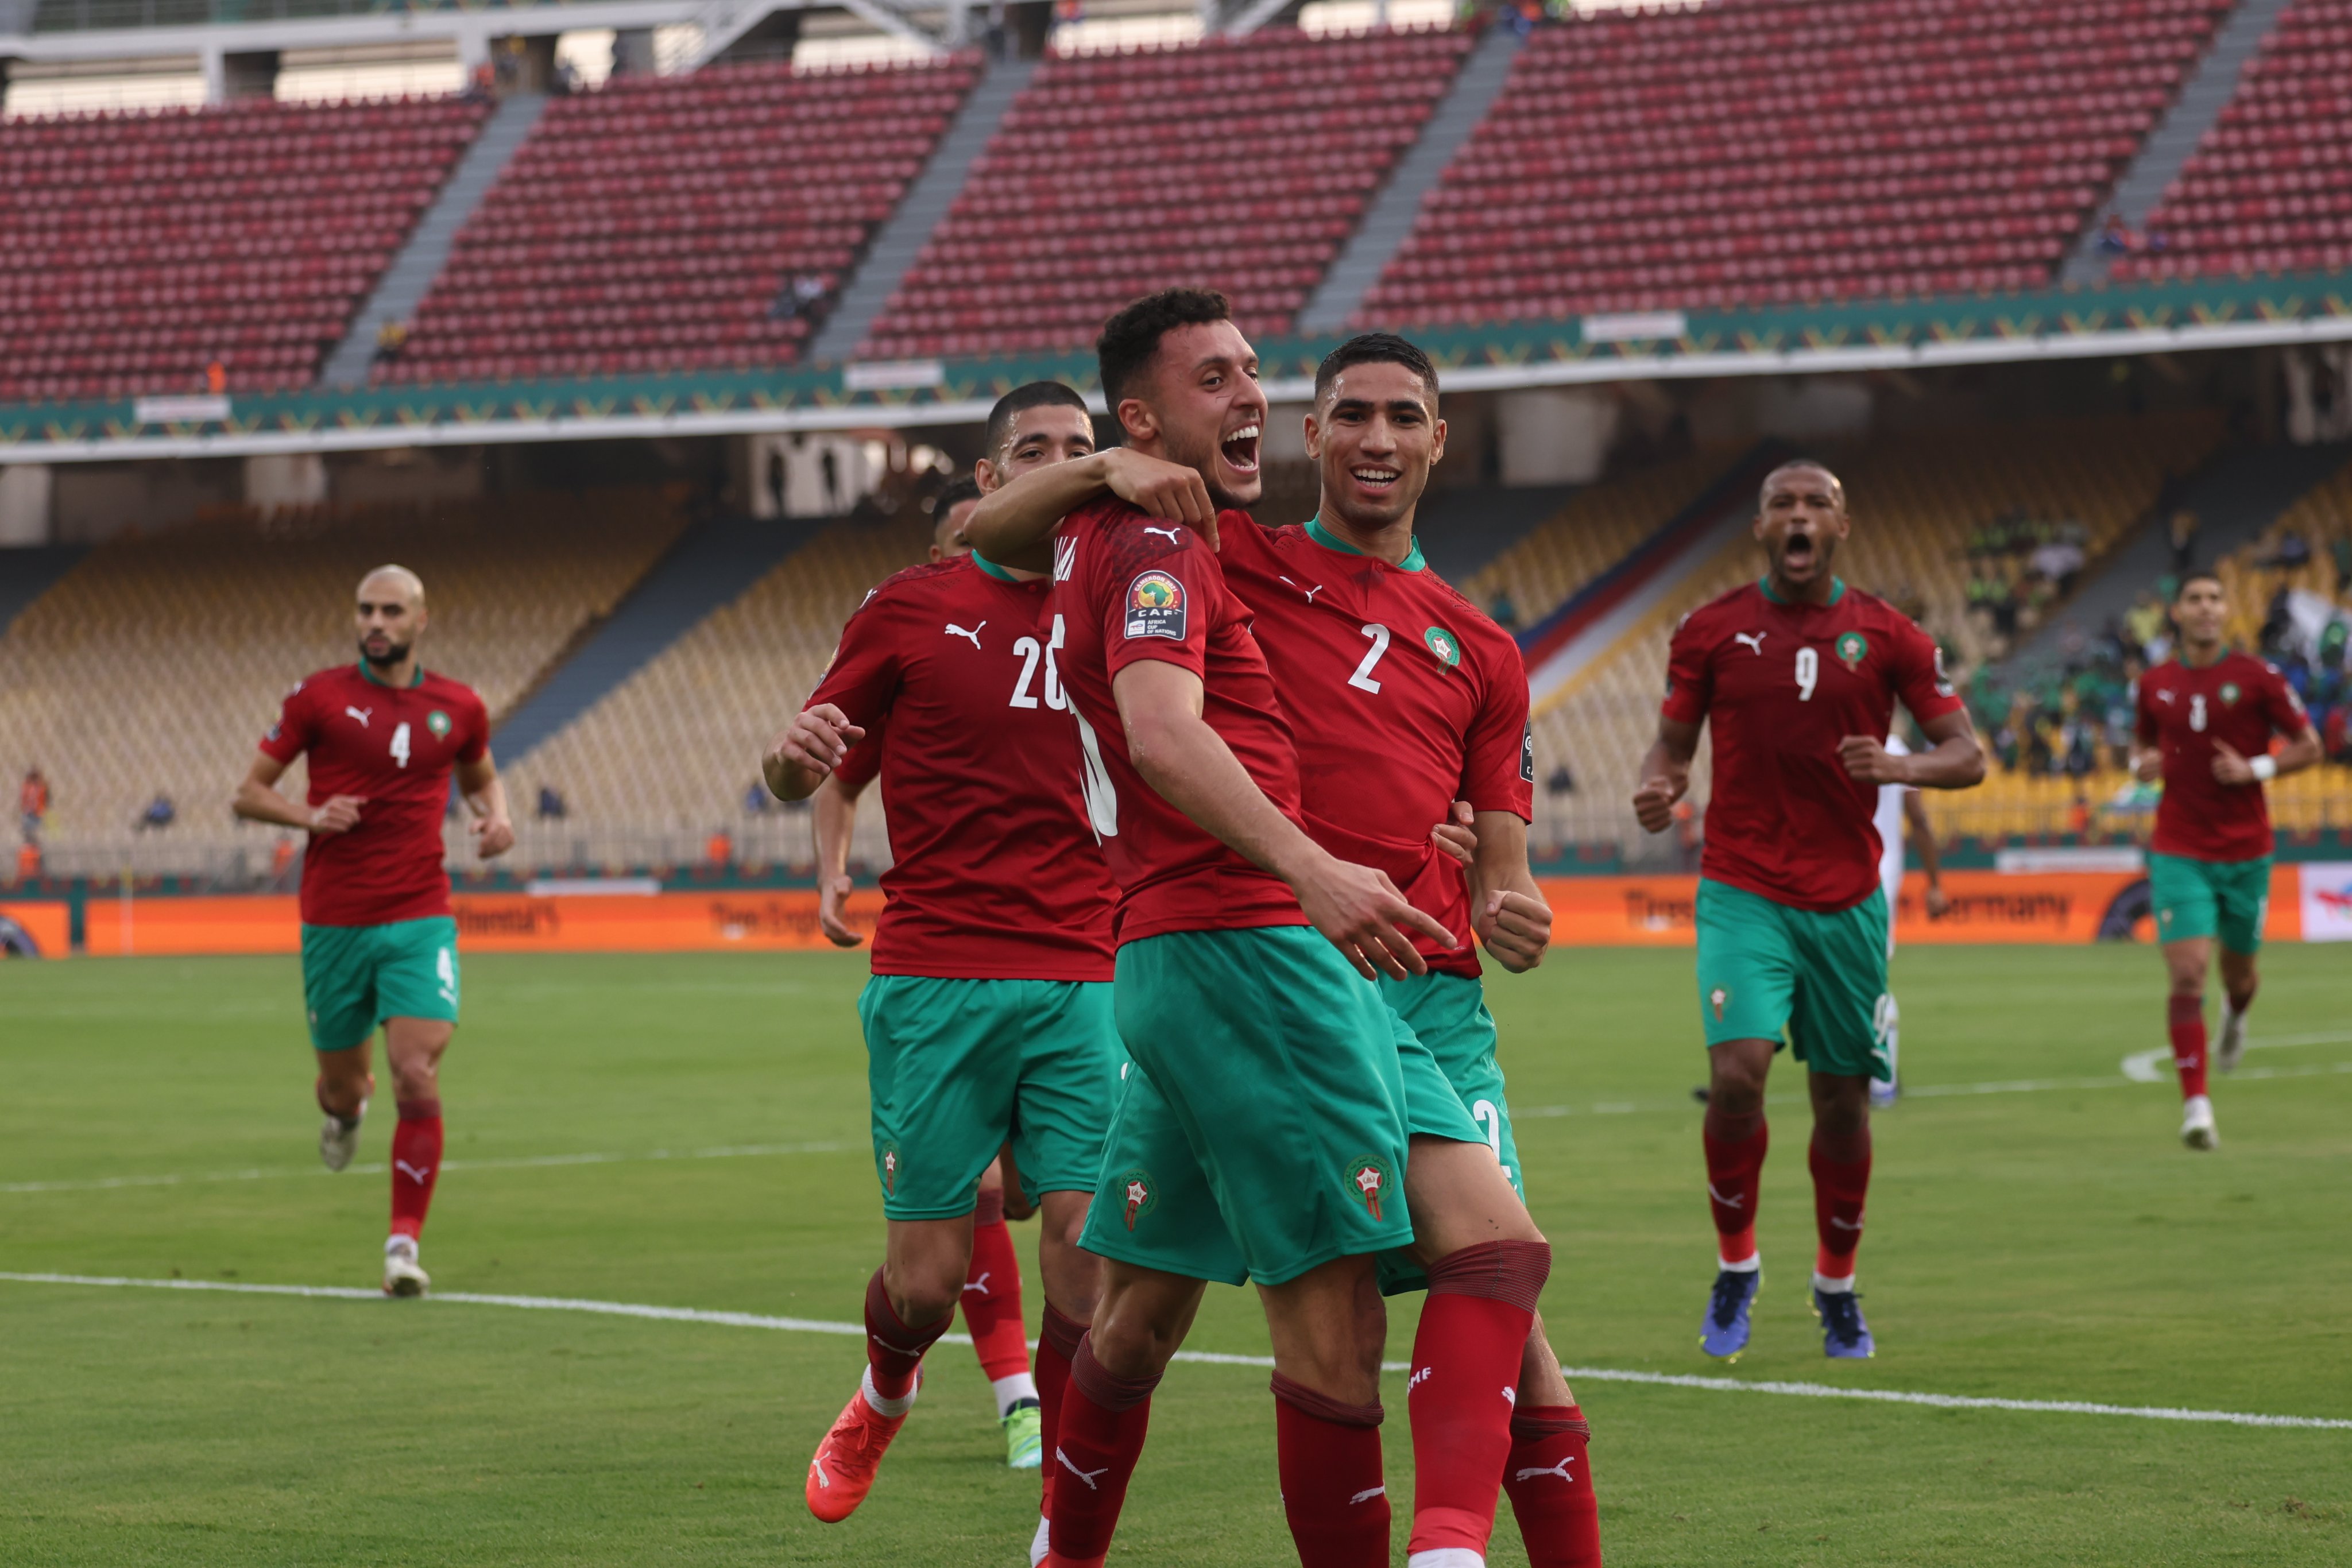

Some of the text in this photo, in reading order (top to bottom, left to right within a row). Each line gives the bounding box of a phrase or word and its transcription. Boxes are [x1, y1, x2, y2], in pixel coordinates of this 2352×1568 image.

[1134, 575, 1178, 592] CAMEROON 2021
[1138, 609, 1173, 617] CAF
[1347, 624, 1390, 695] 2
[1795, 646, 1818, 701] 9
[389, 722, 411, 768] 4
